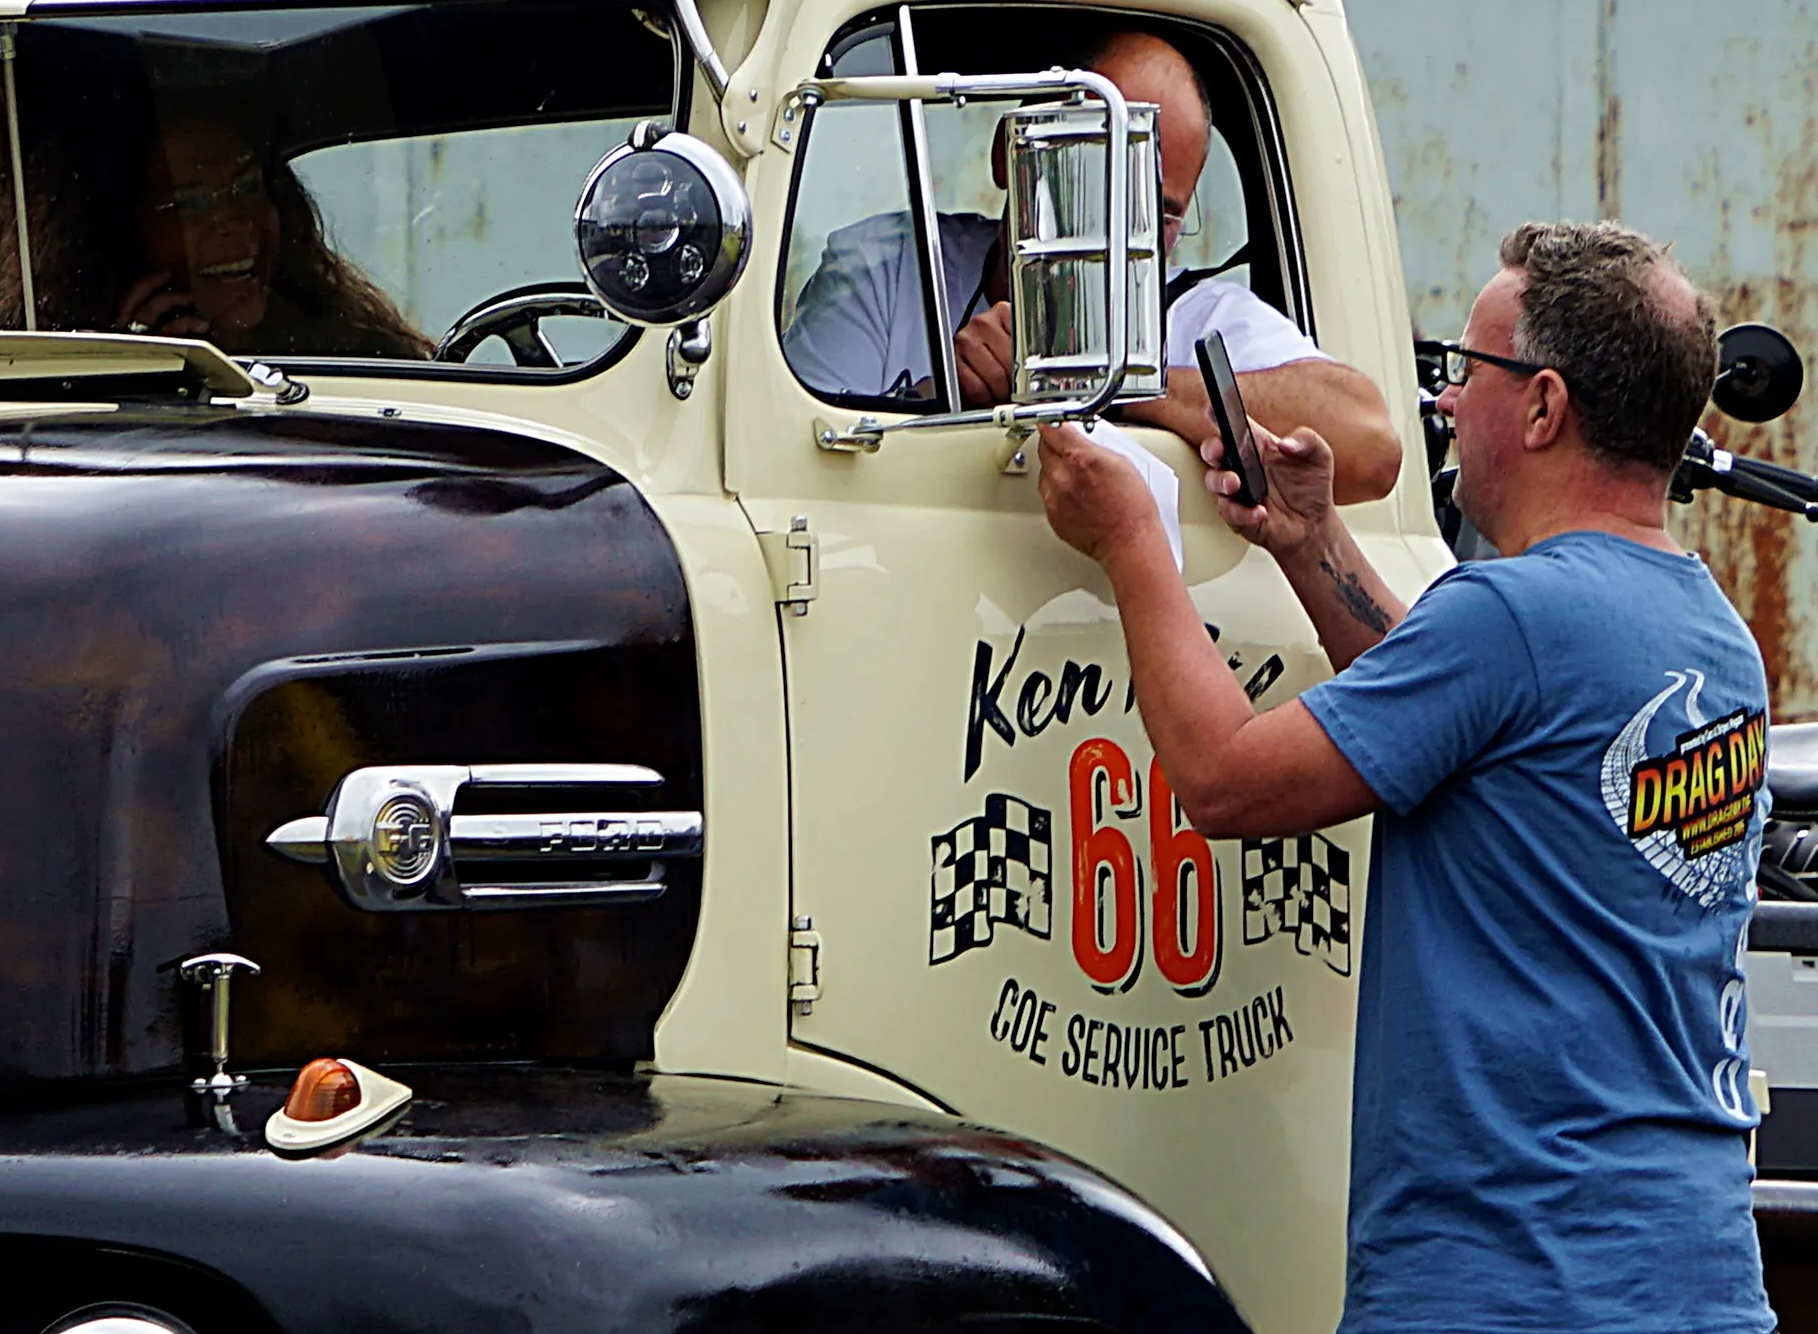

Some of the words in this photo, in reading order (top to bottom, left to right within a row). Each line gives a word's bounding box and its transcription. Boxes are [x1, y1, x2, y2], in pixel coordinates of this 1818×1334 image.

[1633, 741, 1726, 833] DRAG
[1729, 713, 1766, 795] DAY
[539, 819, 665, 852] FORD
[1069, 737, 1222, 998] 66
[990, 978, 1057, 1066] COE
[1062, 1013, 1188, 1091] SERVICE
[1198, 985, 1294, 1084] TRUCK
